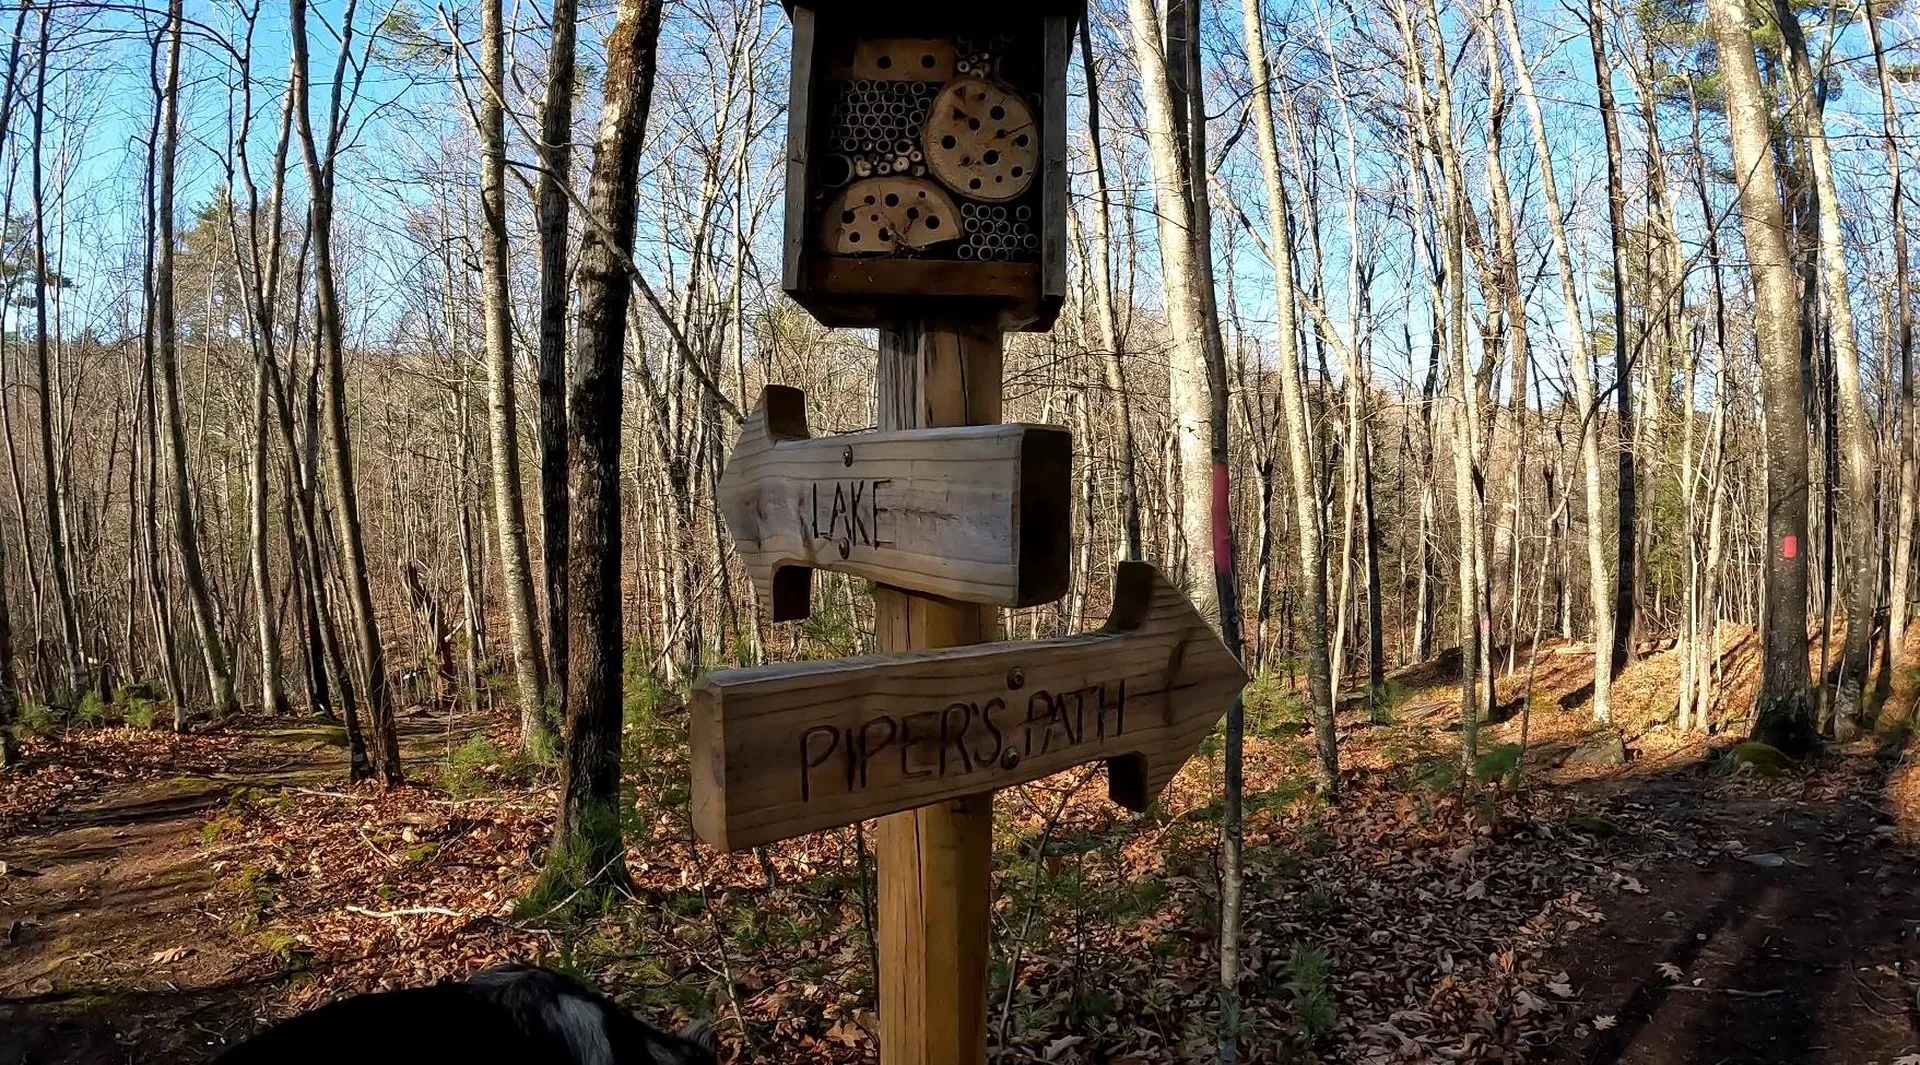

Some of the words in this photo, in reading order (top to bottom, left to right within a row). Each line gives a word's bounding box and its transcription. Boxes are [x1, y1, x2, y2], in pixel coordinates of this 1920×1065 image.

[812, 479, 893, 551] LAKE
[800, 697, 1006, 803] PIPER'S
[1024, 679, 1126, 756] PATH
